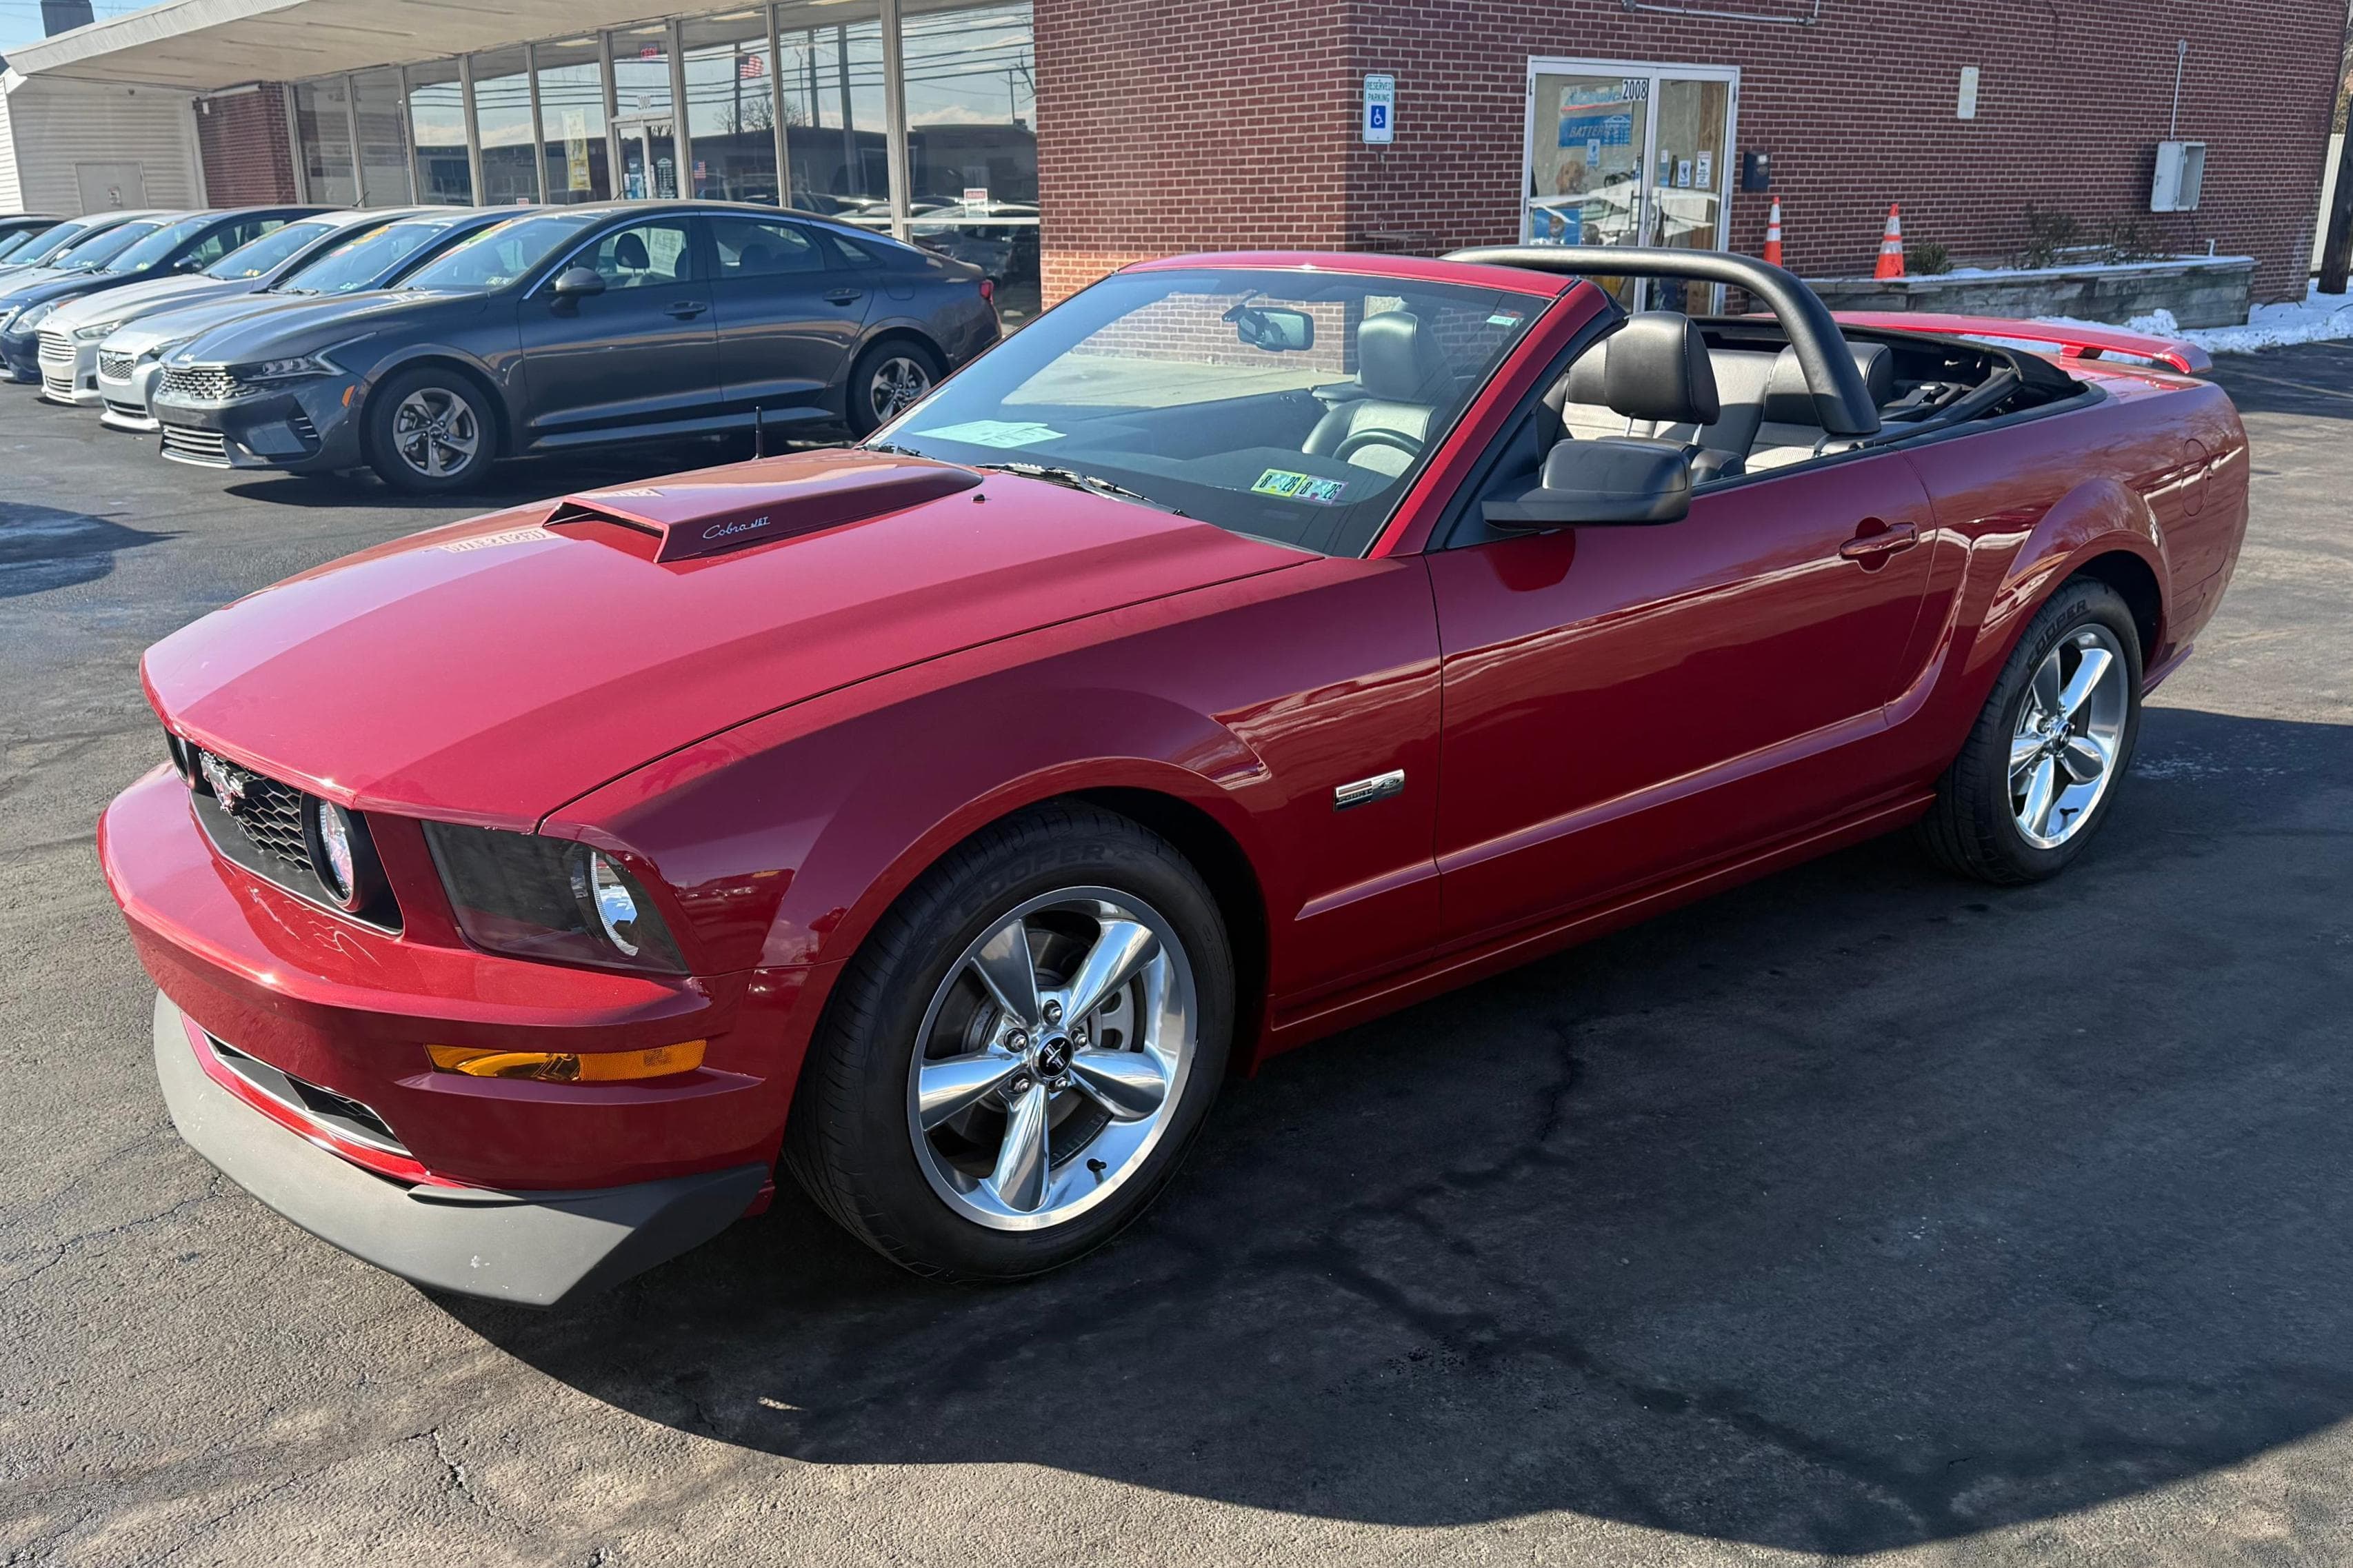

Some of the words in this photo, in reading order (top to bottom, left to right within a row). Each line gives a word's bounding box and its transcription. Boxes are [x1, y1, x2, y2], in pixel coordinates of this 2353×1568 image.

[1366, 81, 1392, 91] RESERVED
[1623, 81, 1647, 100] 2008
[1368, 93, 1390, 102] PARKING
[1259, 475, 1272, 488] 8
[1299, 482, 1313, 494] 8
[1323, 483, 1342, 500] 26
[702, 522, 747, 539] Cobra
